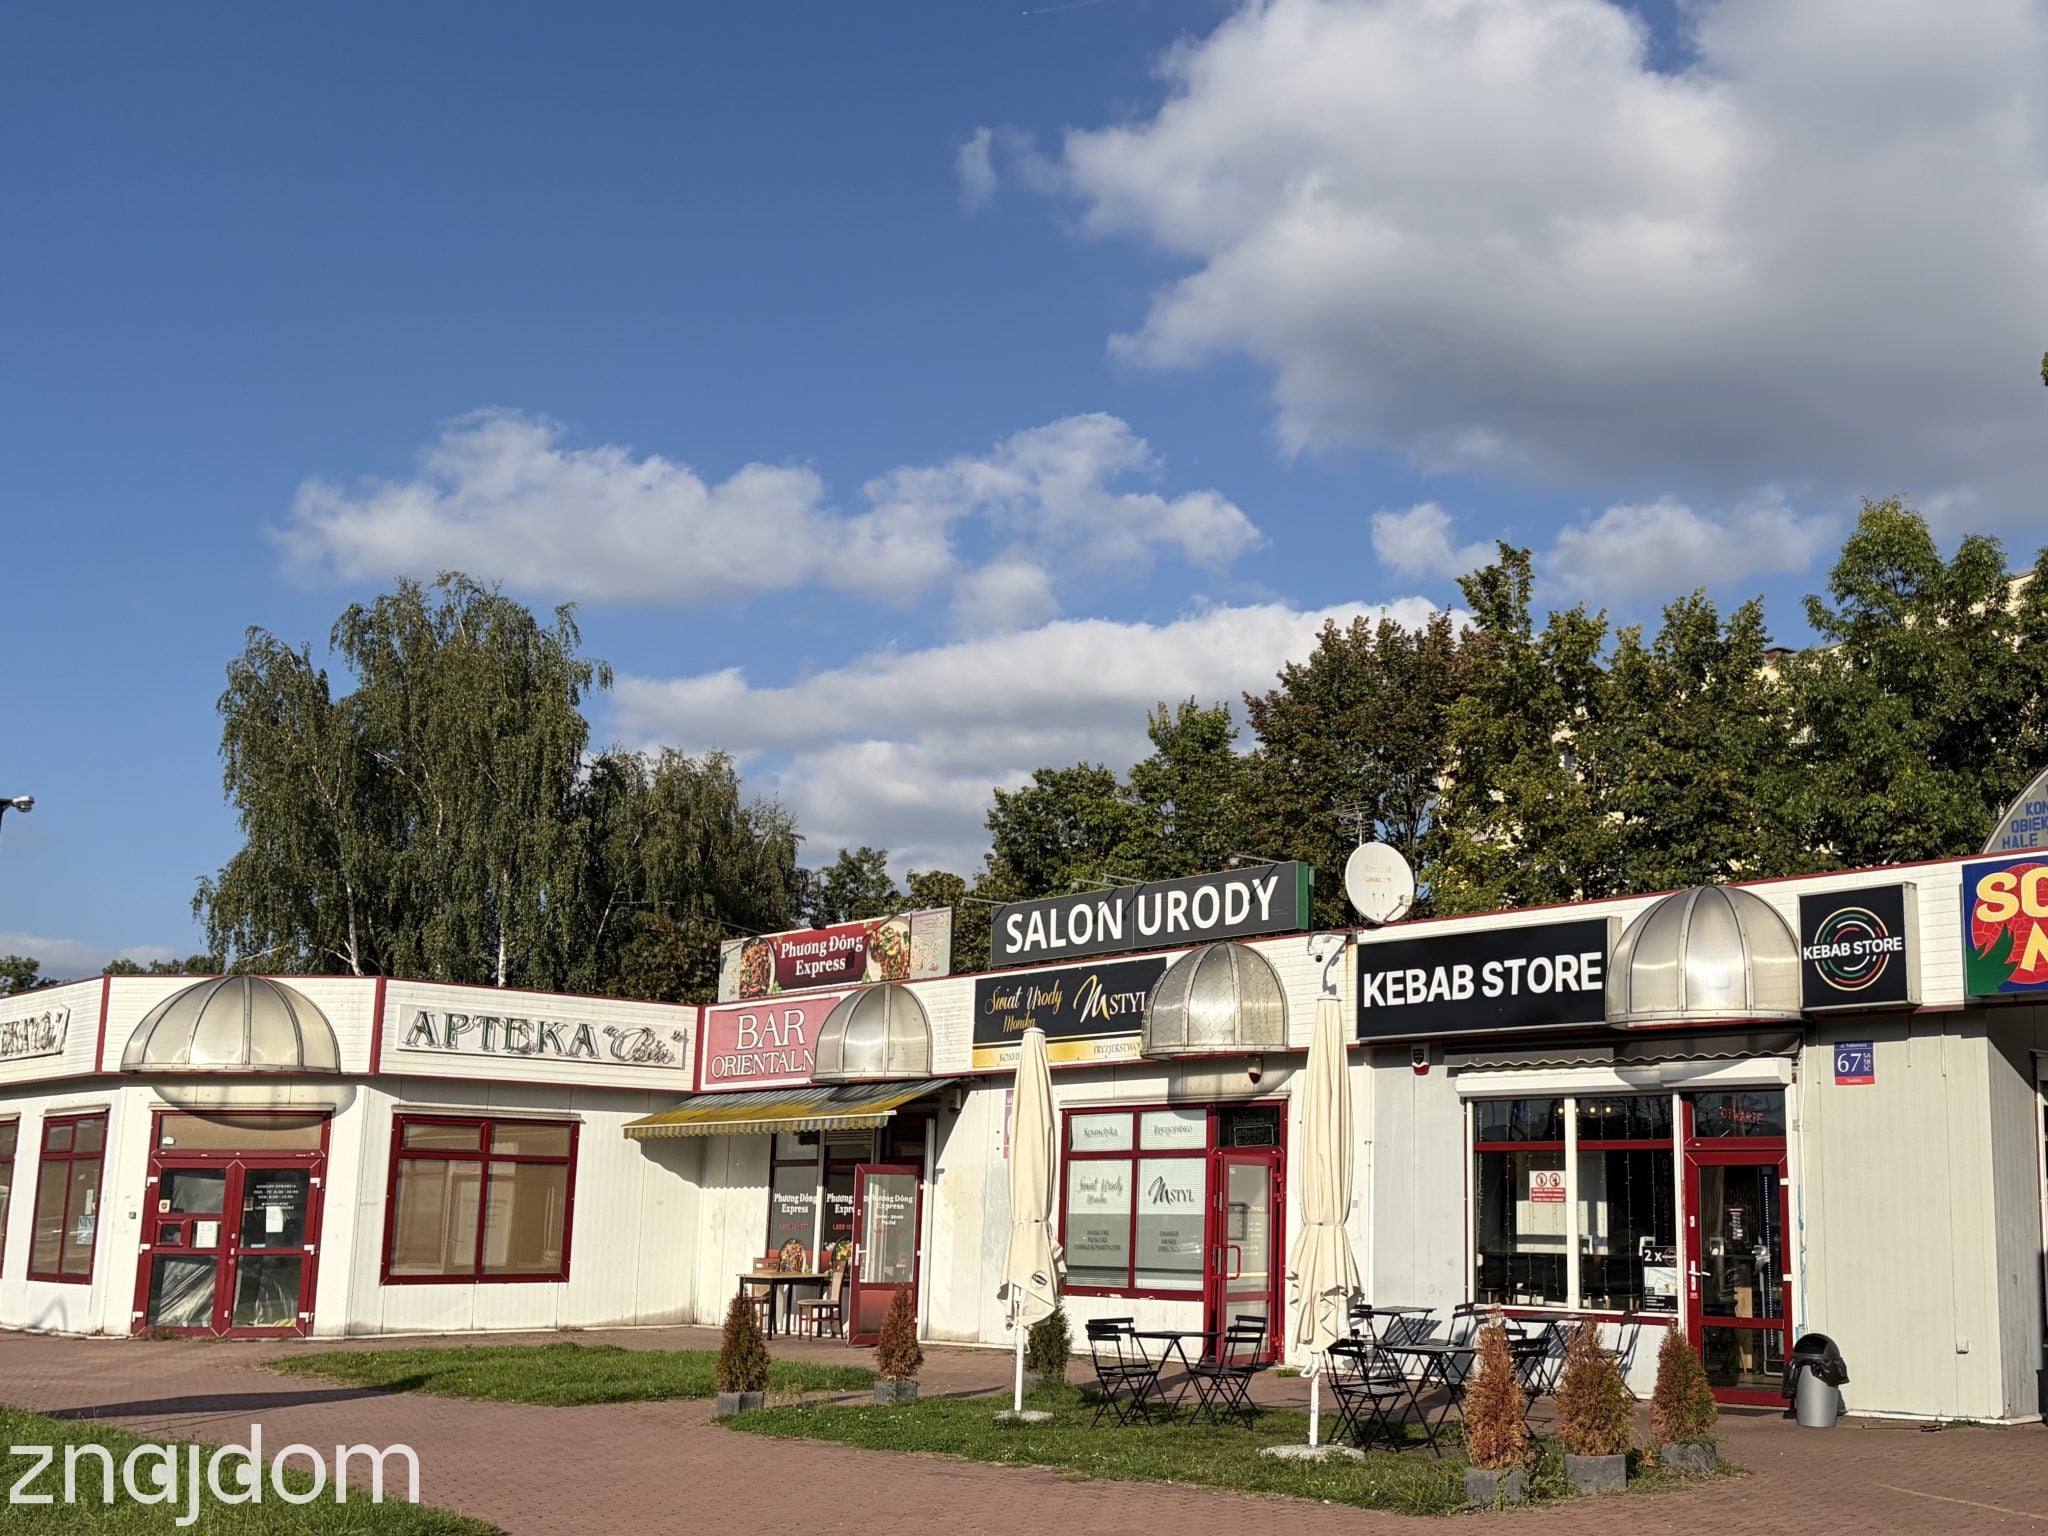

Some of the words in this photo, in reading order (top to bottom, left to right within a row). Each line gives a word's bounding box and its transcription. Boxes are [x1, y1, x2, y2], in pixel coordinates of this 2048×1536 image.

[2001, 833, 2038, 850] HALE
[1005, 898, 1123, 954] SALON
[1137, 876, 1279, 936] URODY
[780, 939, 827, 960] Phương
[828, 934, 864, 953] Đông
[1803, 942, 1851, 961] KEBAB
[1853, 937, 1903, 955] STORE
[795, 957, 846, 978] Express
[1363, 964, 1475, 1008] KEBAB
[1482, 951, 1603, 998] STORE
[401, 1010, 601, 1060] APTEKA
[736, 1008, 806, 1051] BAR
[1093, 1042, 1142, 1056] FRYZJERSTWO
[711, 1049, 816, 1078] ORIENTALN
[1837, 1053, 1862, 1073] 67
[781, 1204, 809, 1215] Express
[834, 1204, 854, 1216] Expr
[1644, 1249, 1653, 1262] 2
